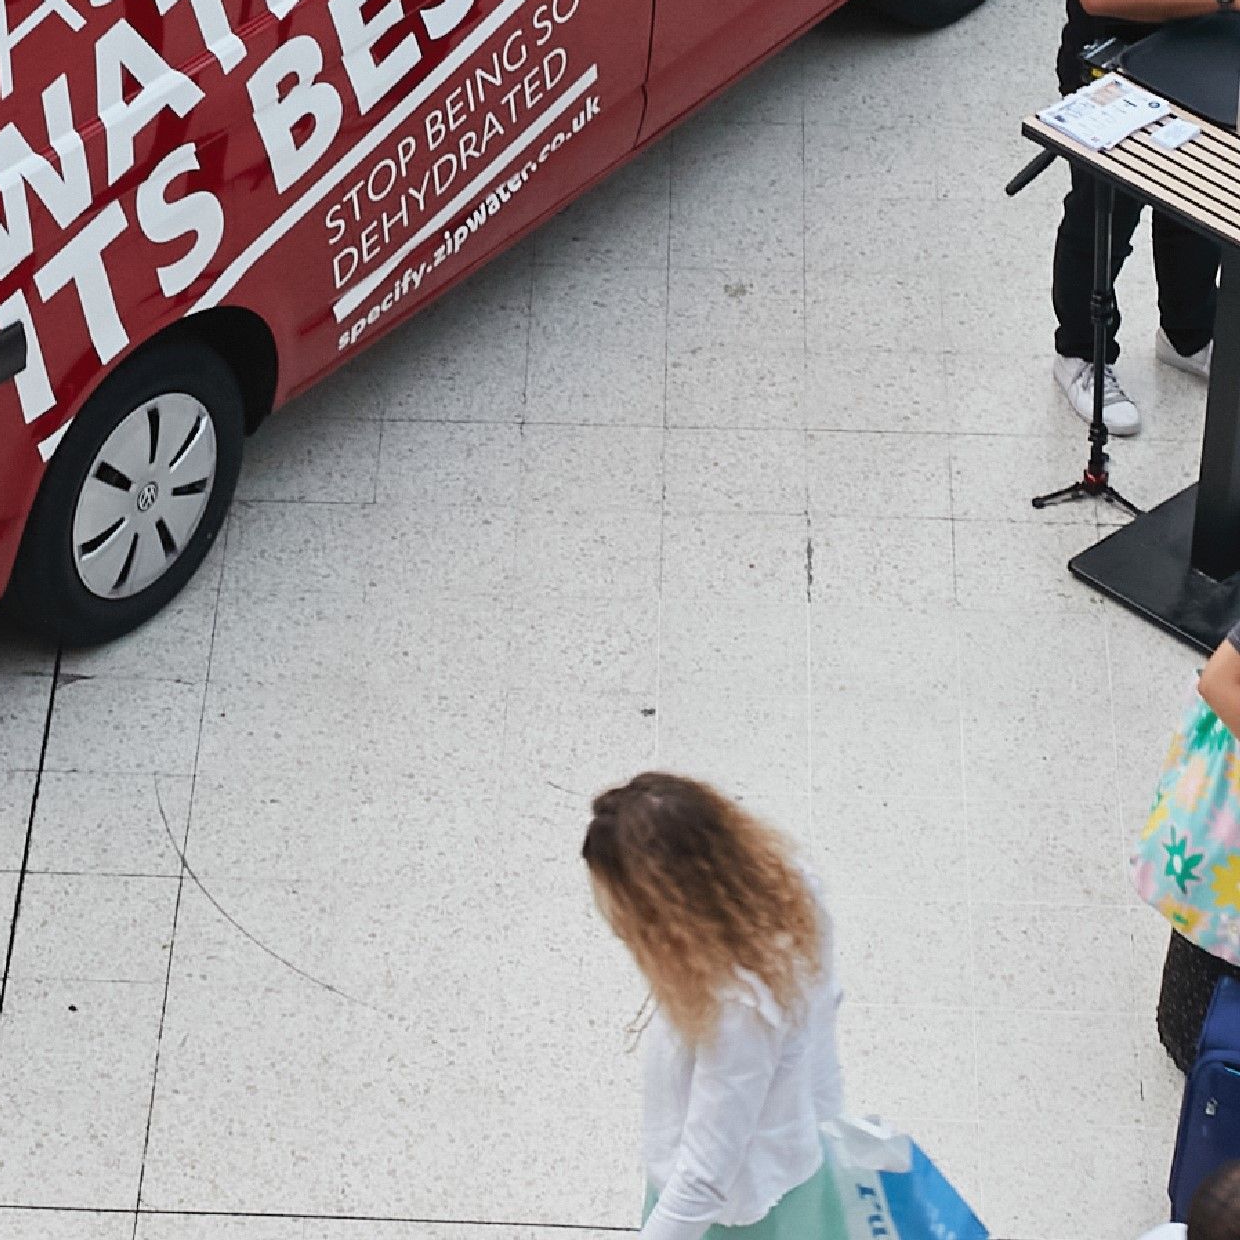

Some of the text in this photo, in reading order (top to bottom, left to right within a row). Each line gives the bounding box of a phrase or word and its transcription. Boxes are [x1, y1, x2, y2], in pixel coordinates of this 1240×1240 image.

[325, 135, 416, 245] STOP
[425, 28, 527, 151] BEING
[332, 46, 568, 289] DEHYDRATED
[337, 95, 602, 351] specify.zipwater.co.uk
